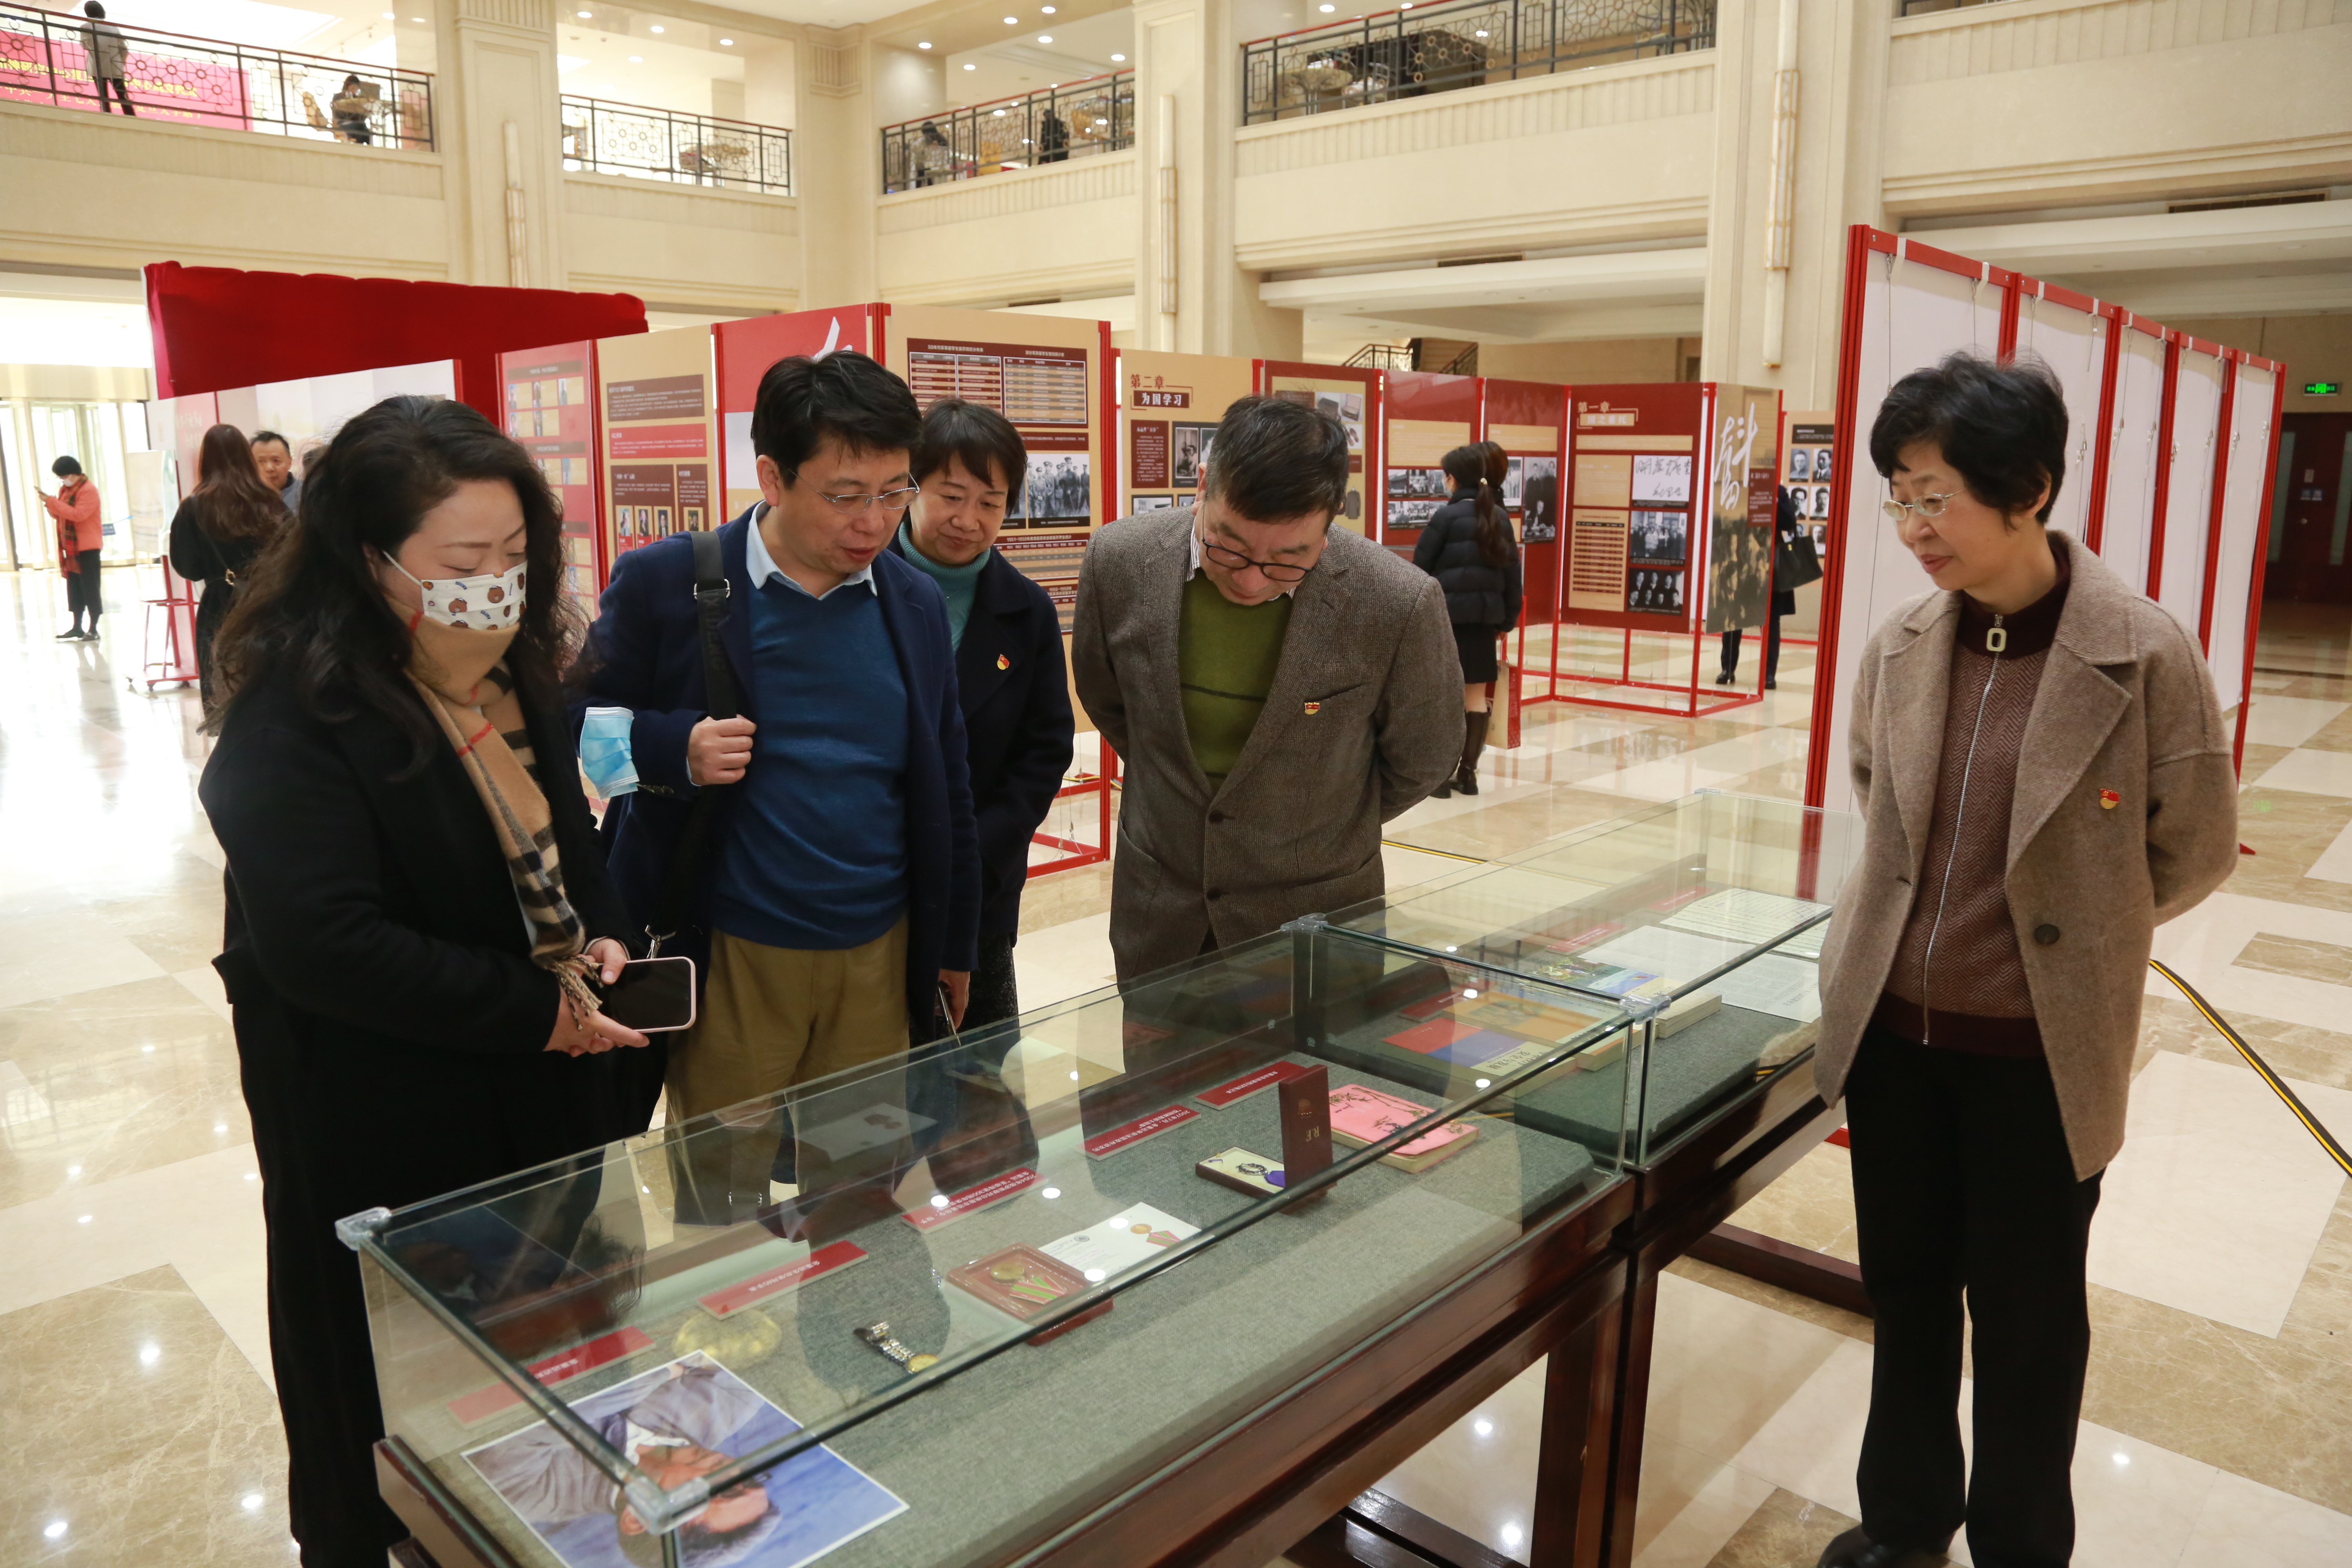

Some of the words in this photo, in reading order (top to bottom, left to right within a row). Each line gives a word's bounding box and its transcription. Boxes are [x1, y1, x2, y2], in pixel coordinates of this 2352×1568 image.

[1131, 374, 1164, 390] 第二章
[1142, 392, 1182, 406] 为国学习
[1578, 401, 1610, 413] 第一章
[1486, 1051, 1532, 1070] 安全与发展
